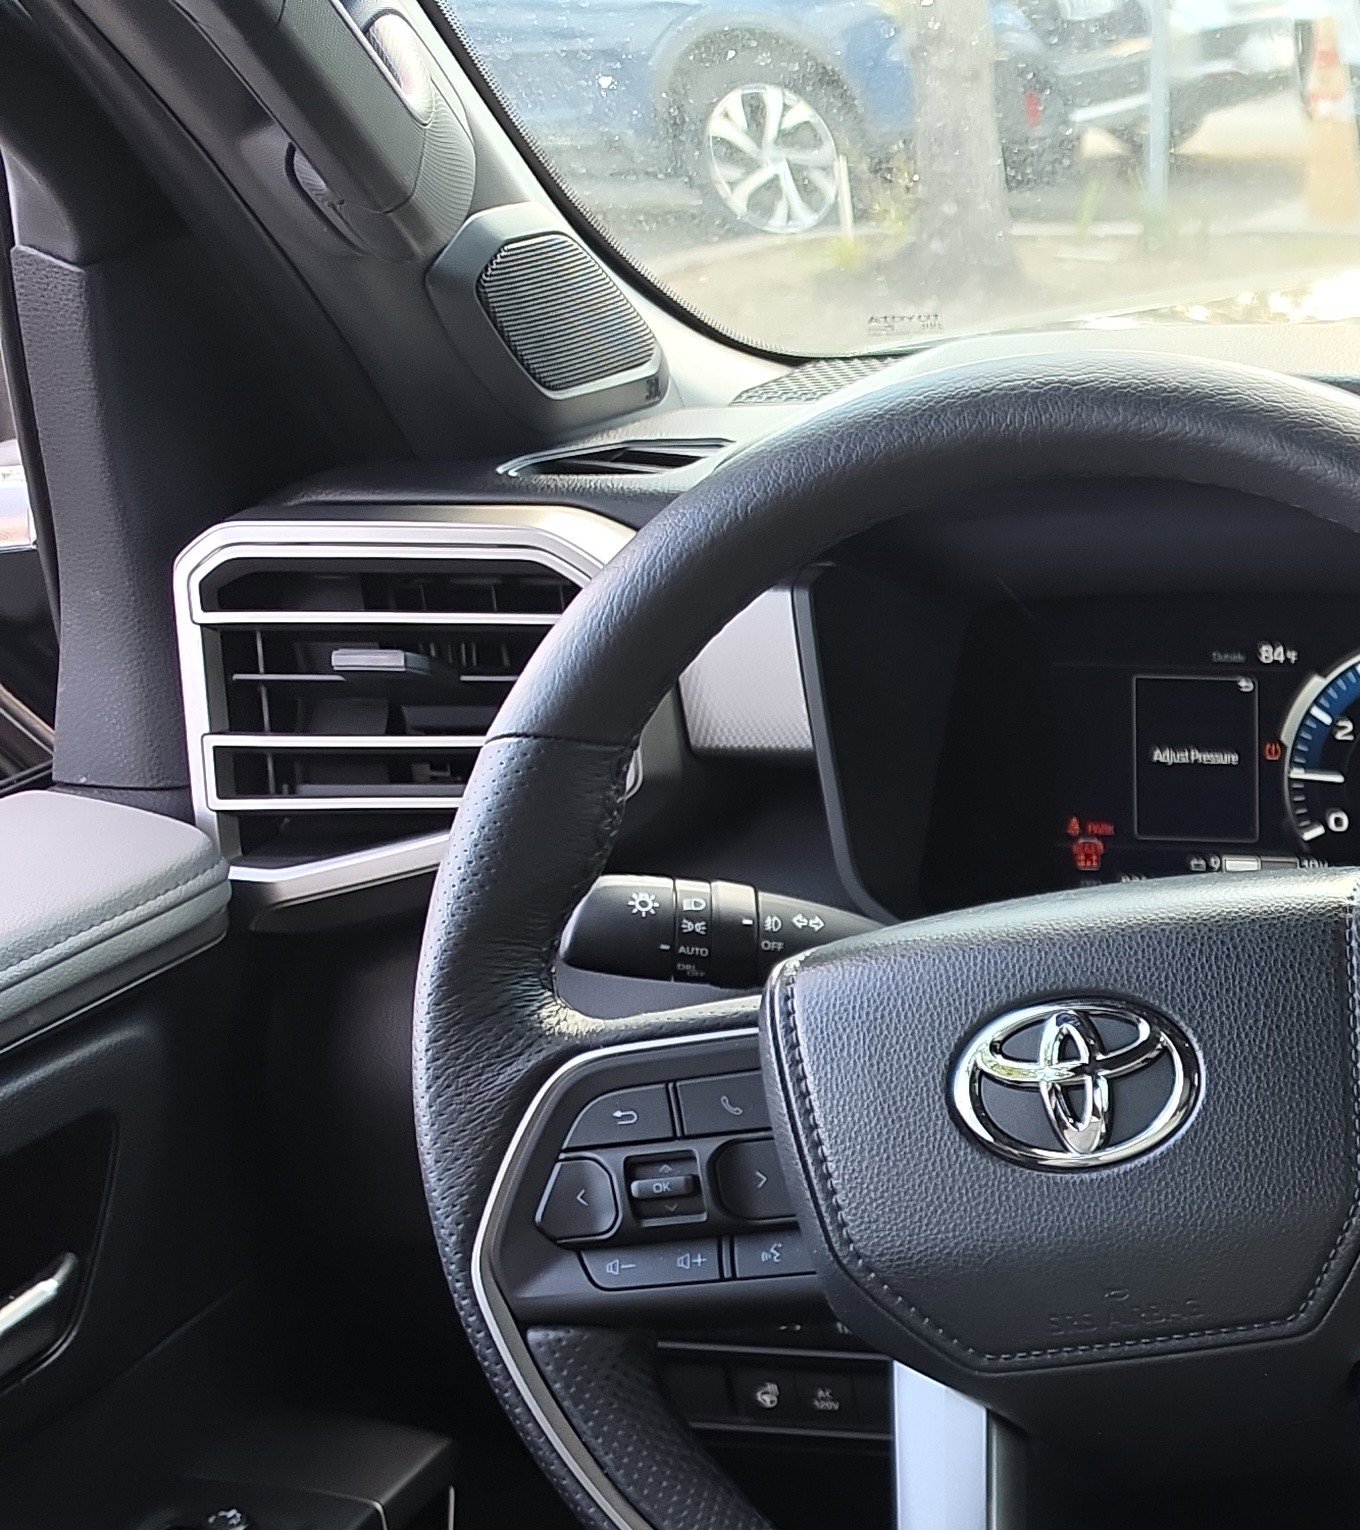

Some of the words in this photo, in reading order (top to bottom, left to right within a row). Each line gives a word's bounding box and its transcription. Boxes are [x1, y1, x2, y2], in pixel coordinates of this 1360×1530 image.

[1335, 720, 1355, 741] 2
[1152, 747, 1189, 765] Adjust
[1190, 747, 1239, 765] Pressure
[1327, 809, 1349, 832] 0
[678, 945, 709, 957] AUTO
[760, 940, 784, 951] OFF
[651, 1182, 672, 1194] OK
